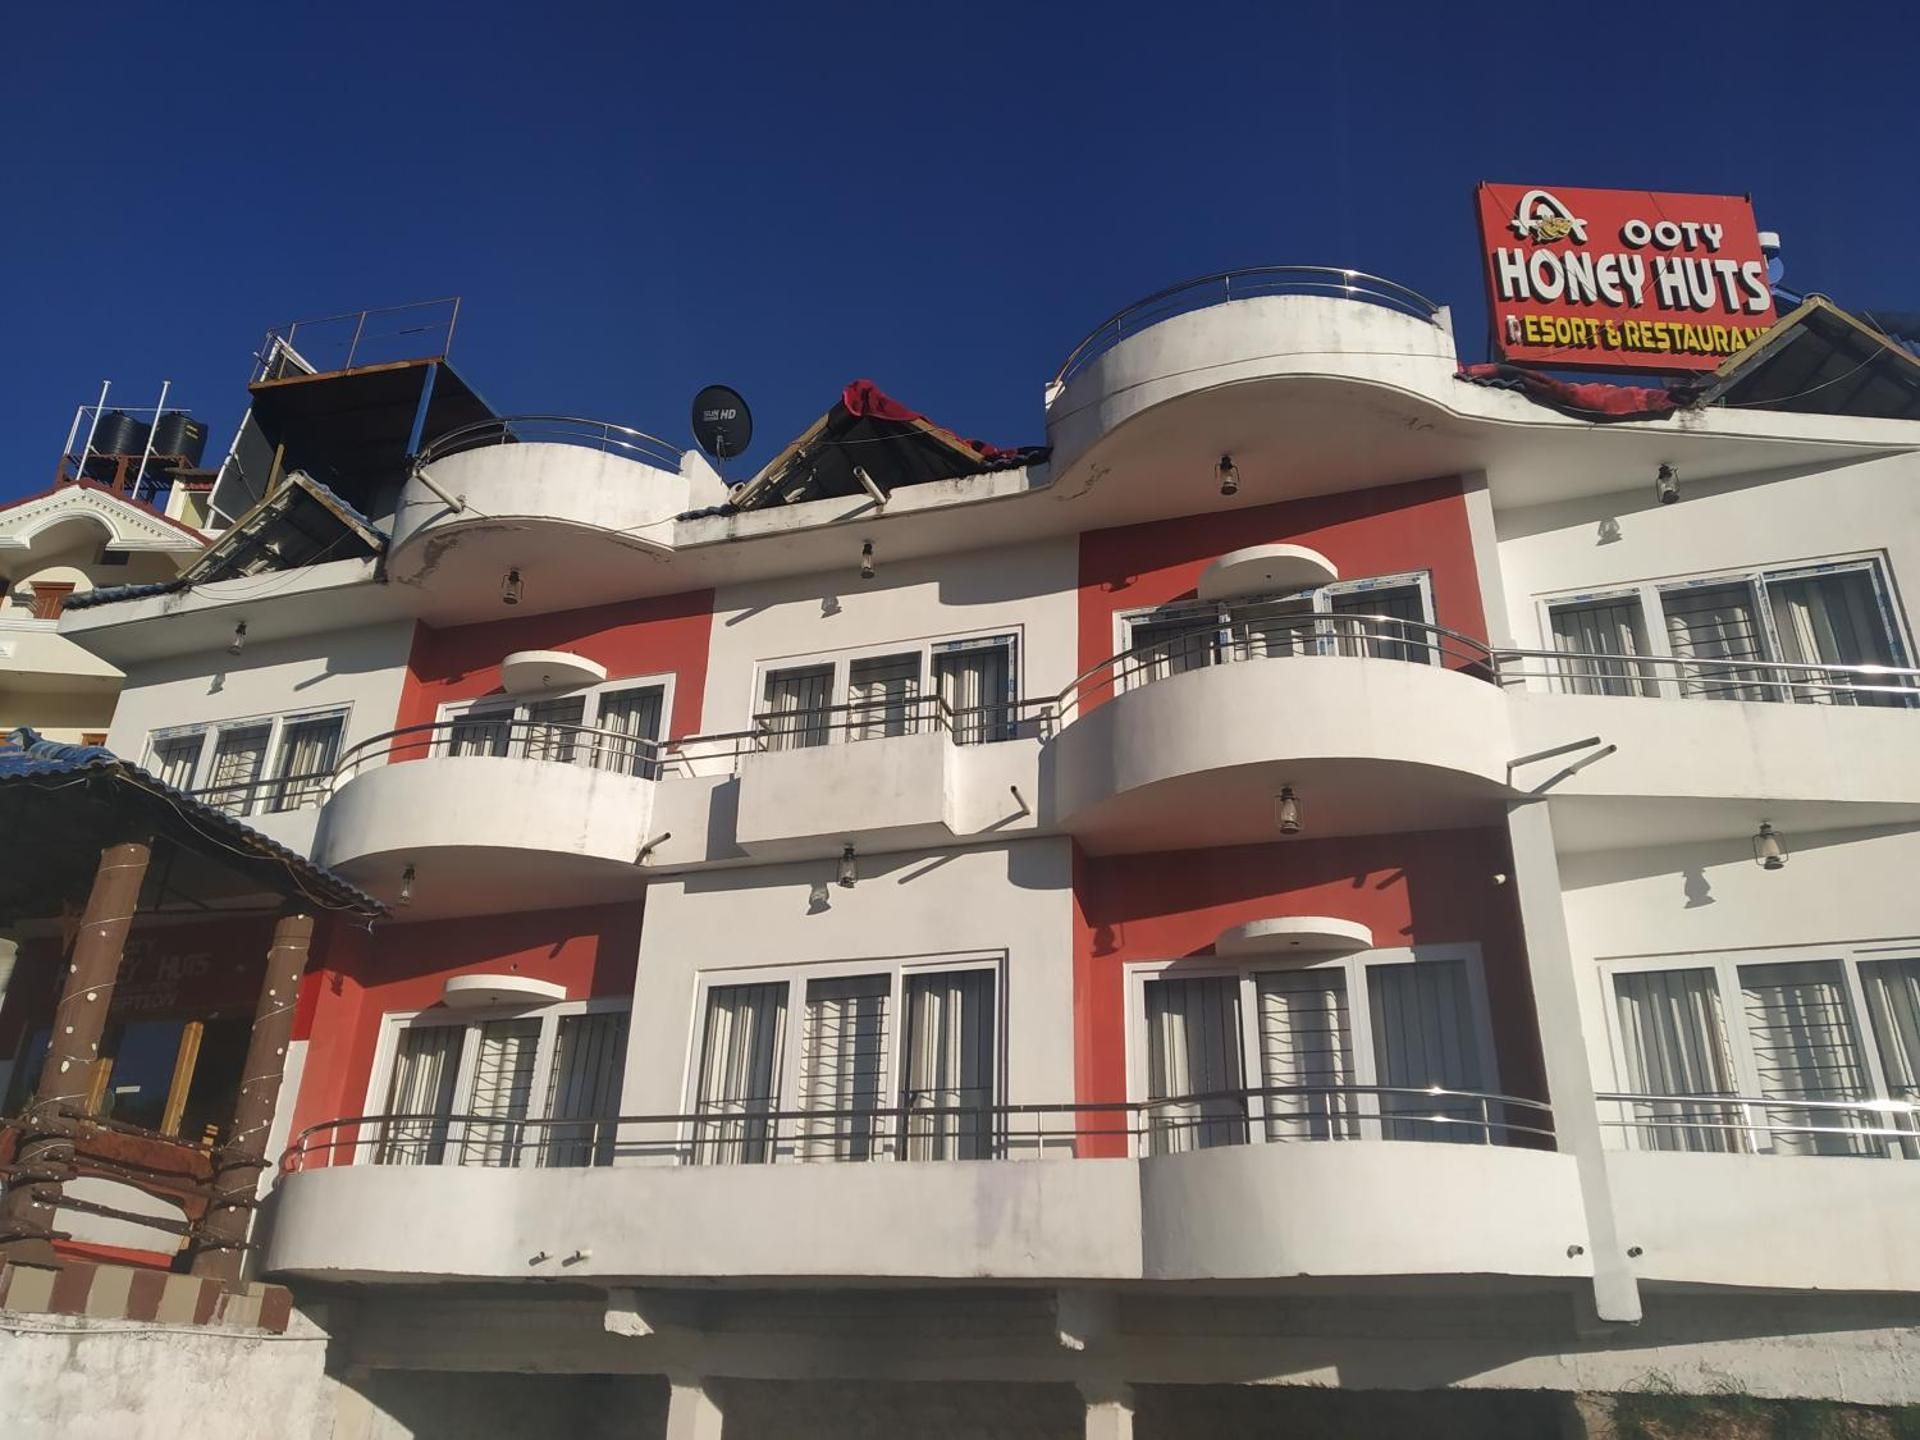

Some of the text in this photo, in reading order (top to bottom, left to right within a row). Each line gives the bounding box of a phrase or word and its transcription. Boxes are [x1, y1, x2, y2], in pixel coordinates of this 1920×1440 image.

[1623, 218, 1723, 249] OOTY
[1497, 246, 1772, 312] HONEY HUTS
[1623, 319, 1771, 353] RESTAURAN
[720, 408, 737, 420] HD
